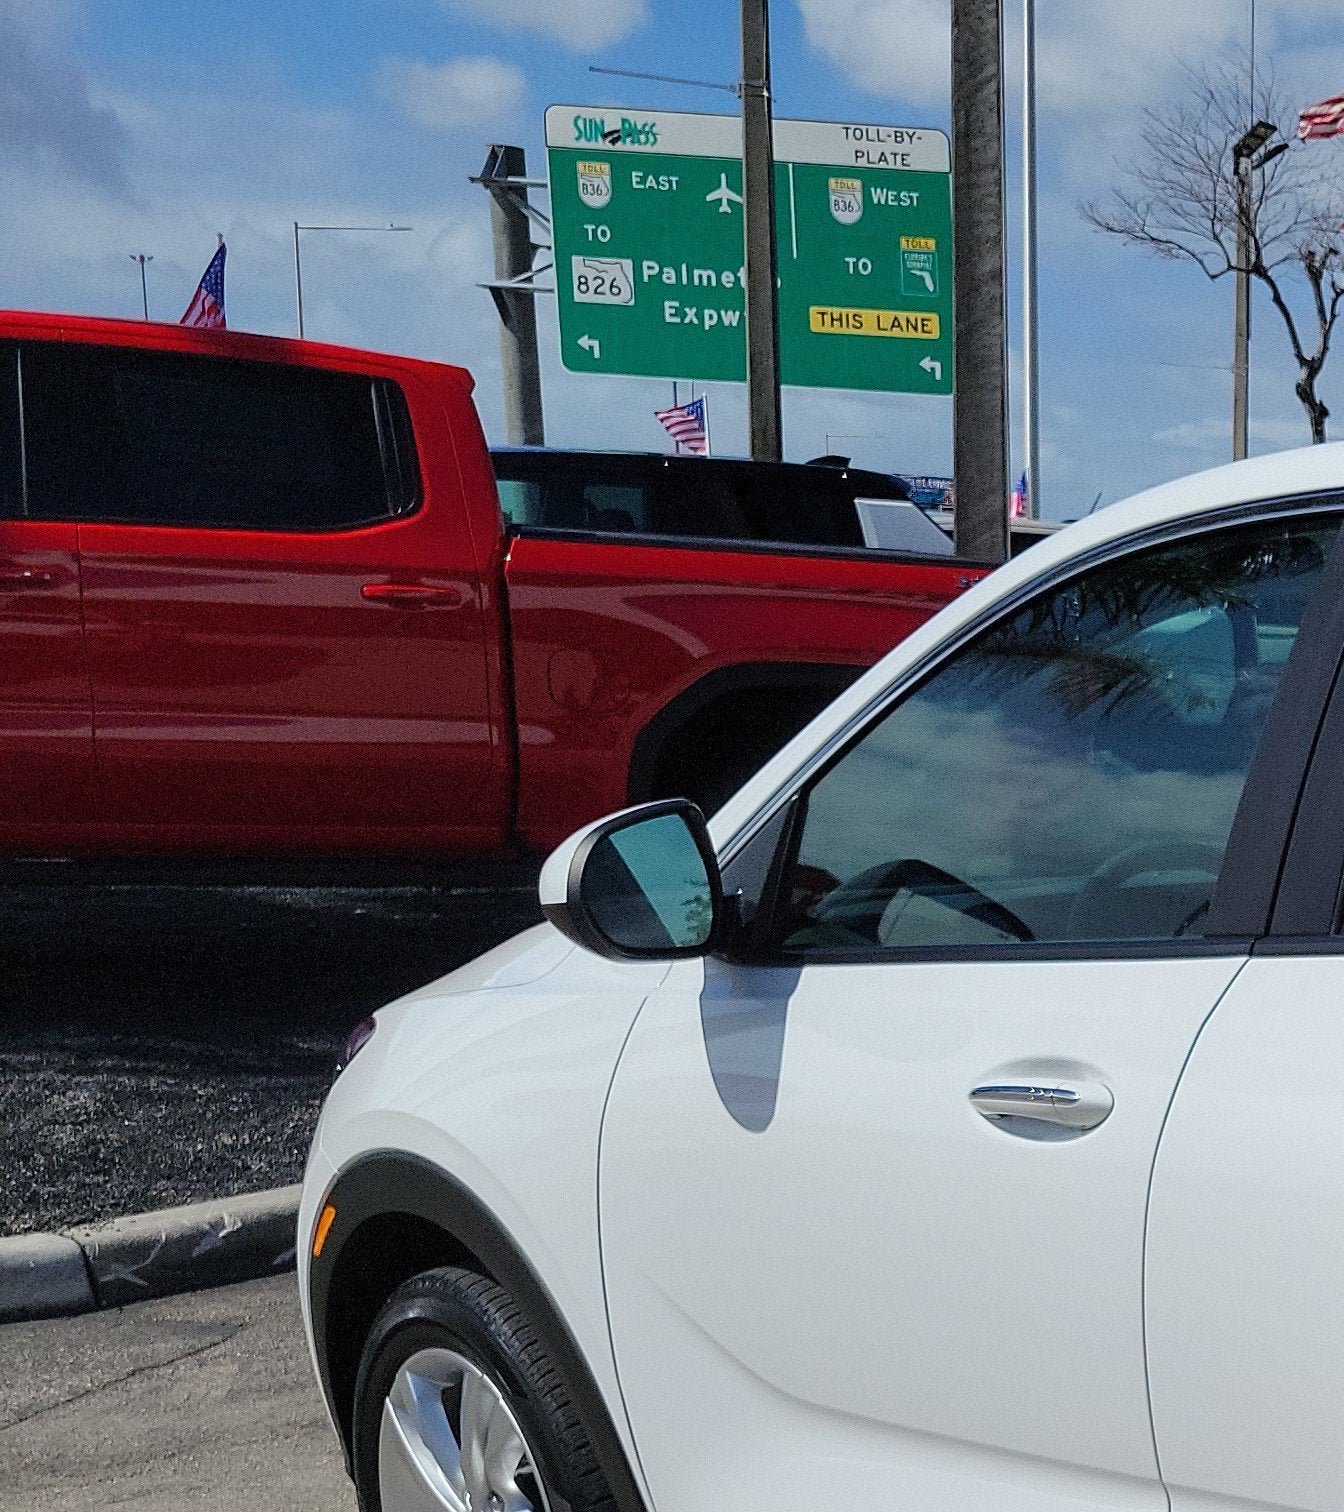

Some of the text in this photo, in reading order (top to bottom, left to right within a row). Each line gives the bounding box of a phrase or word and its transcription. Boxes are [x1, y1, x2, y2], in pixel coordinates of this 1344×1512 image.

[842, 126, 923, 145] TOLL-BY-
[855, 150, 911, 167] PLATE
[582, 183, 603, 196] 836
[631, 170, 680, 191] EAST
[833, 199, 854, 213] 836
[870, 187, 920, 207] WEST
[583, 224, 611, 243] TO
[905, 238, 932, 250] TOLL
[844, 257, 872, 276] TO
[577, 275, 622, 297] 826
[664, 300, 746, 331] Expw
[816, 311, 933, 334] THIS LANE
